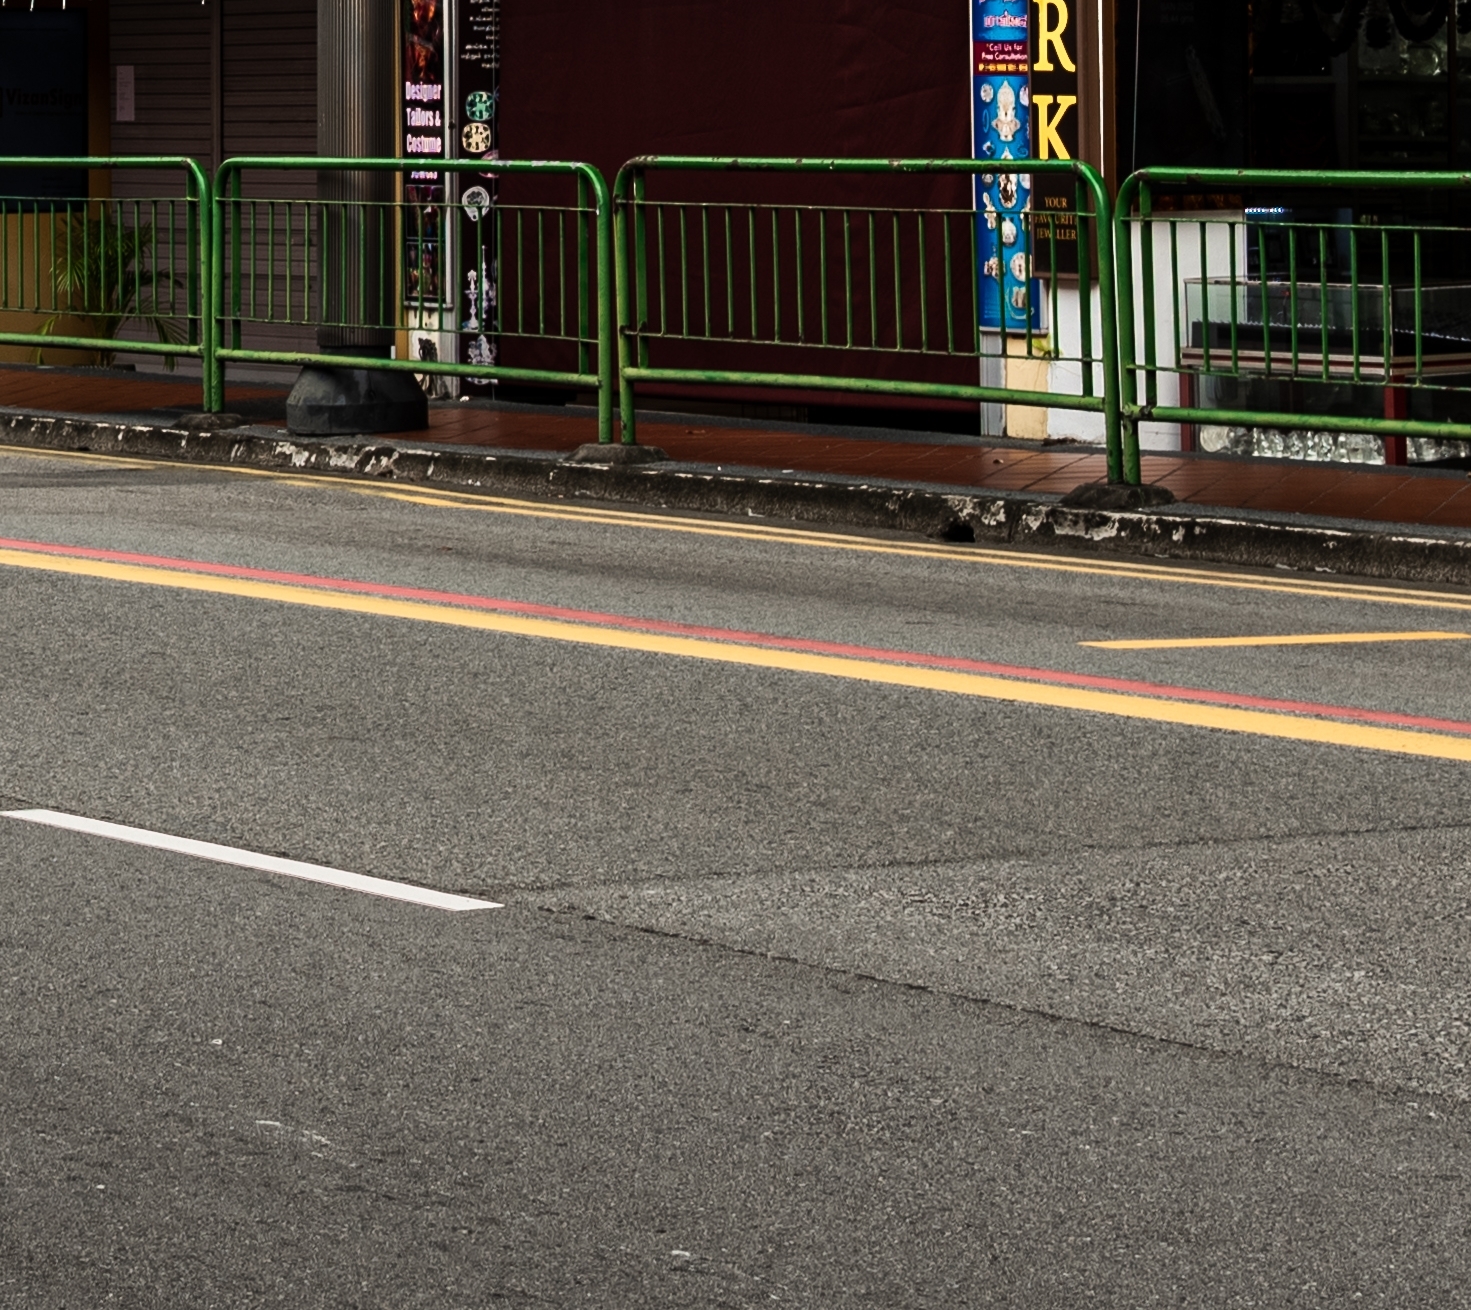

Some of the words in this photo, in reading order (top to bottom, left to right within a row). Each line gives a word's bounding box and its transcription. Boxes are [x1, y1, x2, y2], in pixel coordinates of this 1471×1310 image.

[405, 81, 442, 101] Designer
[406, 107, 434, 127] Tailors
[434, 111, 442, 127] &
[1044, 196, 1068, 208] YOUR
[1036, 227, 1077, 240] JEWLLER
